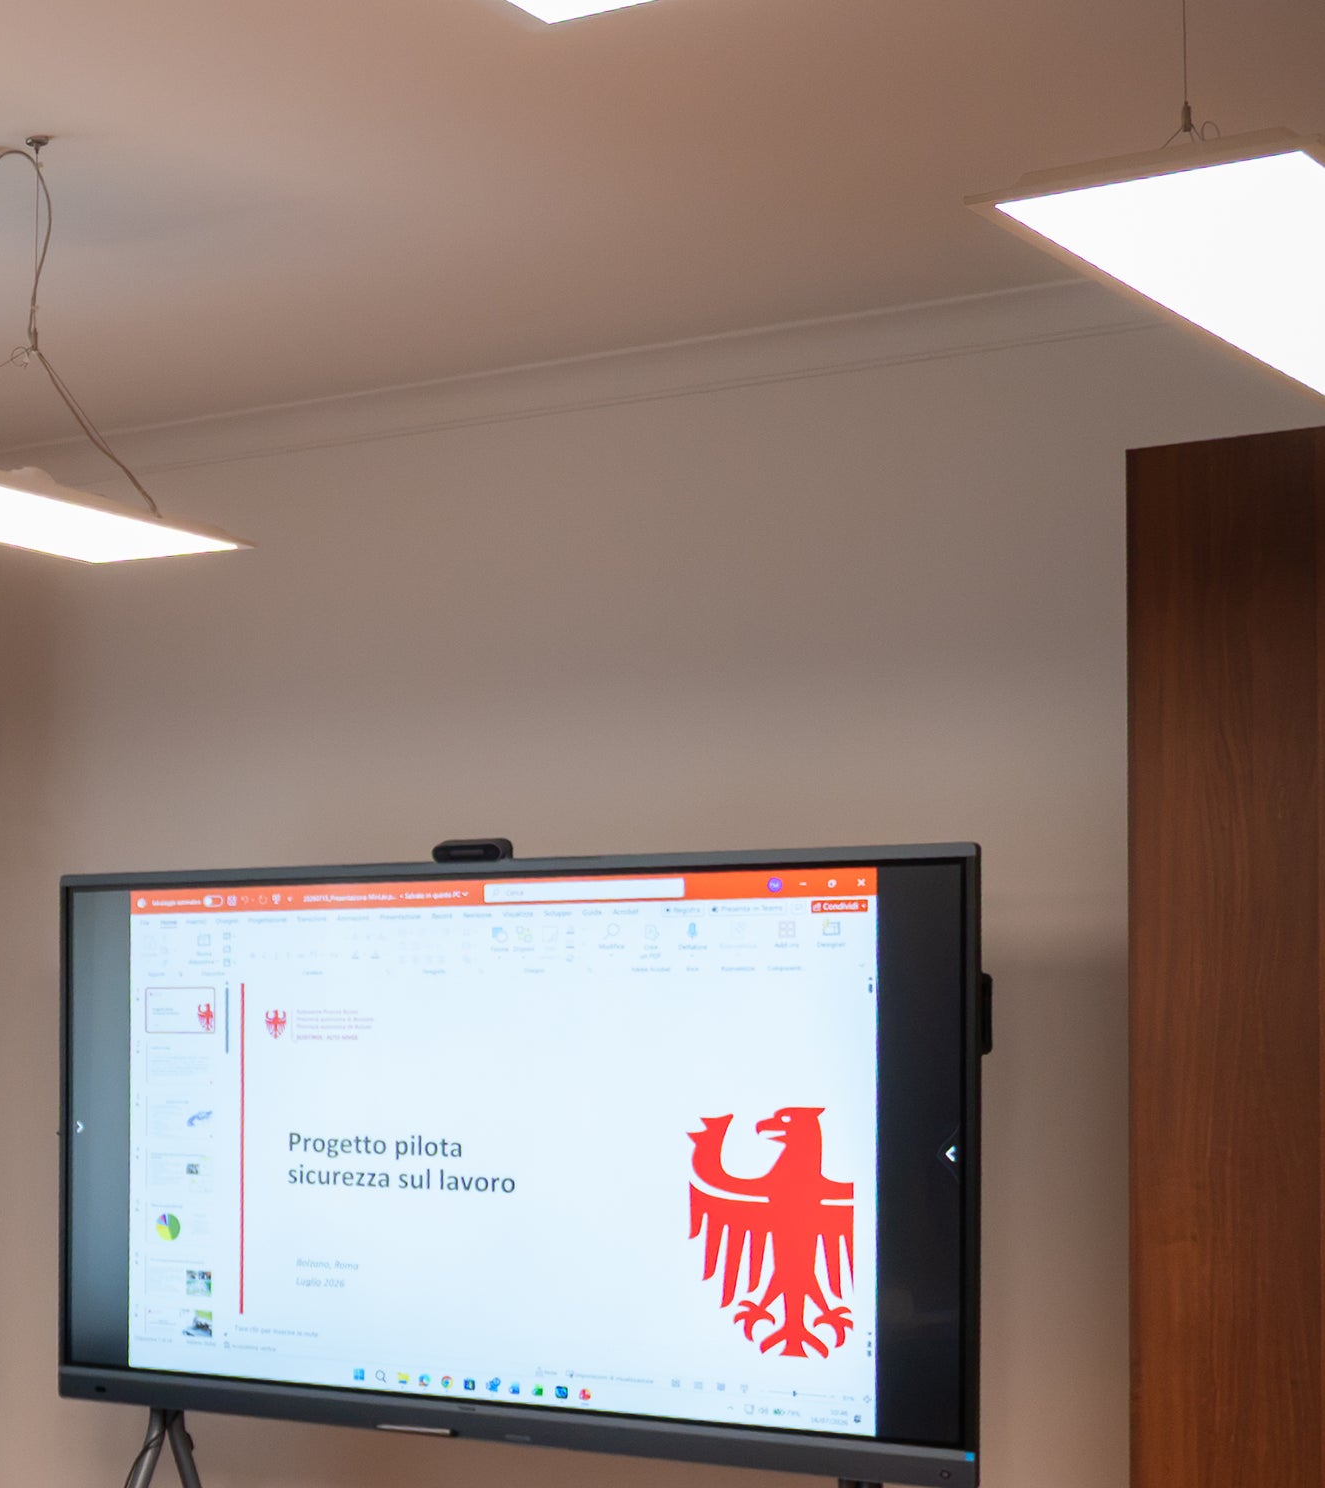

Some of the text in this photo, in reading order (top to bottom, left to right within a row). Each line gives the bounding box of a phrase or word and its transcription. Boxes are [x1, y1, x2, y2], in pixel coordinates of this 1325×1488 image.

[288, 1132, 463, 1160] Progetto pilota
[287, 1164, 516, 1194] sicurezza sul lavoro
